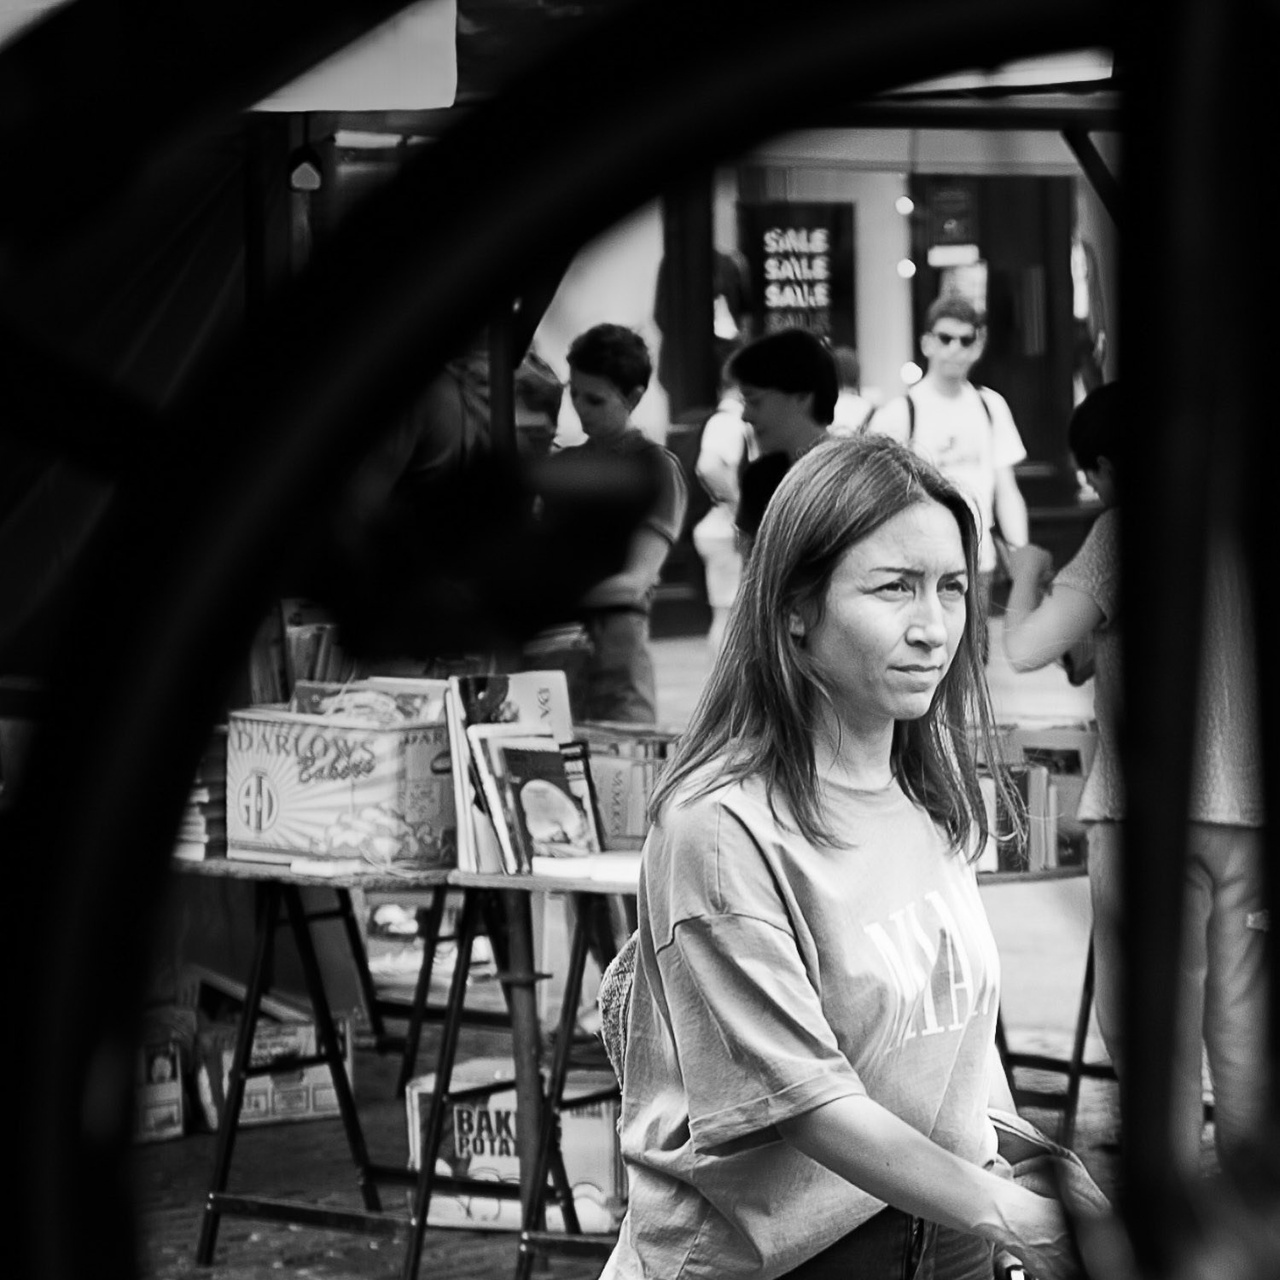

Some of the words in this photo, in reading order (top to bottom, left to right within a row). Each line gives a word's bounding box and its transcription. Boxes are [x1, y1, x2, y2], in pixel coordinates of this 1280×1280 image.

[764, 227, 829, 253] SALE
[764, 255, 829, 280] SALE
[765, 282, 829, 308] SALE
[456, 1108, 516, 1139] BAK
[458, 1137, 515, 1157] POTA
